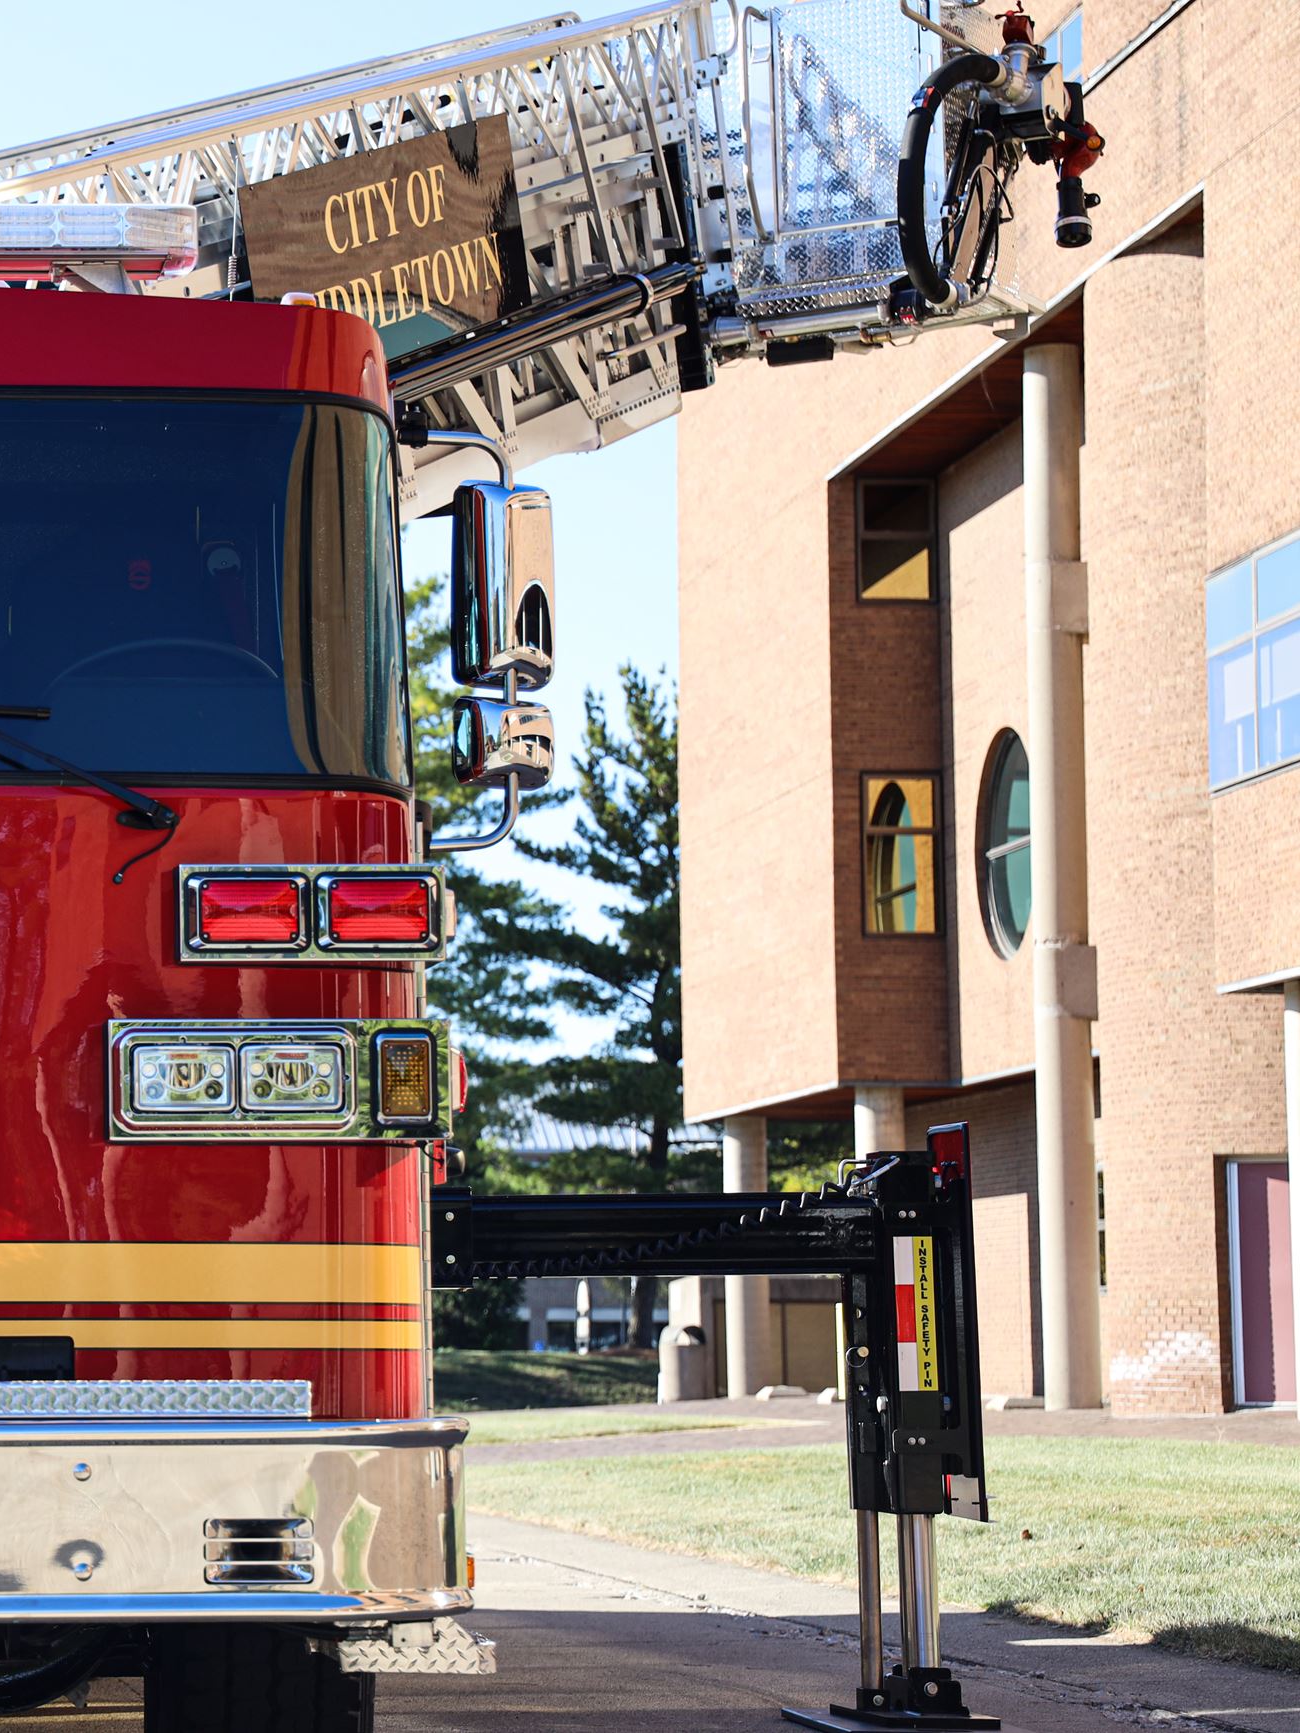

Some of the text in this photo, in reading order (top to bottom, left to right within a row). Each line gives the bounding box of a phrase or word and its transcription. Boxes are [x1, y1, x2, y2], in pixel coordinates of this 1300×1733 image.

[324, 164, 445, 254] CITY OF
[315, 232, 503, 328] DLETOWN
[918, 1239, 932, 1388] INSTALL SAFETY PIN
